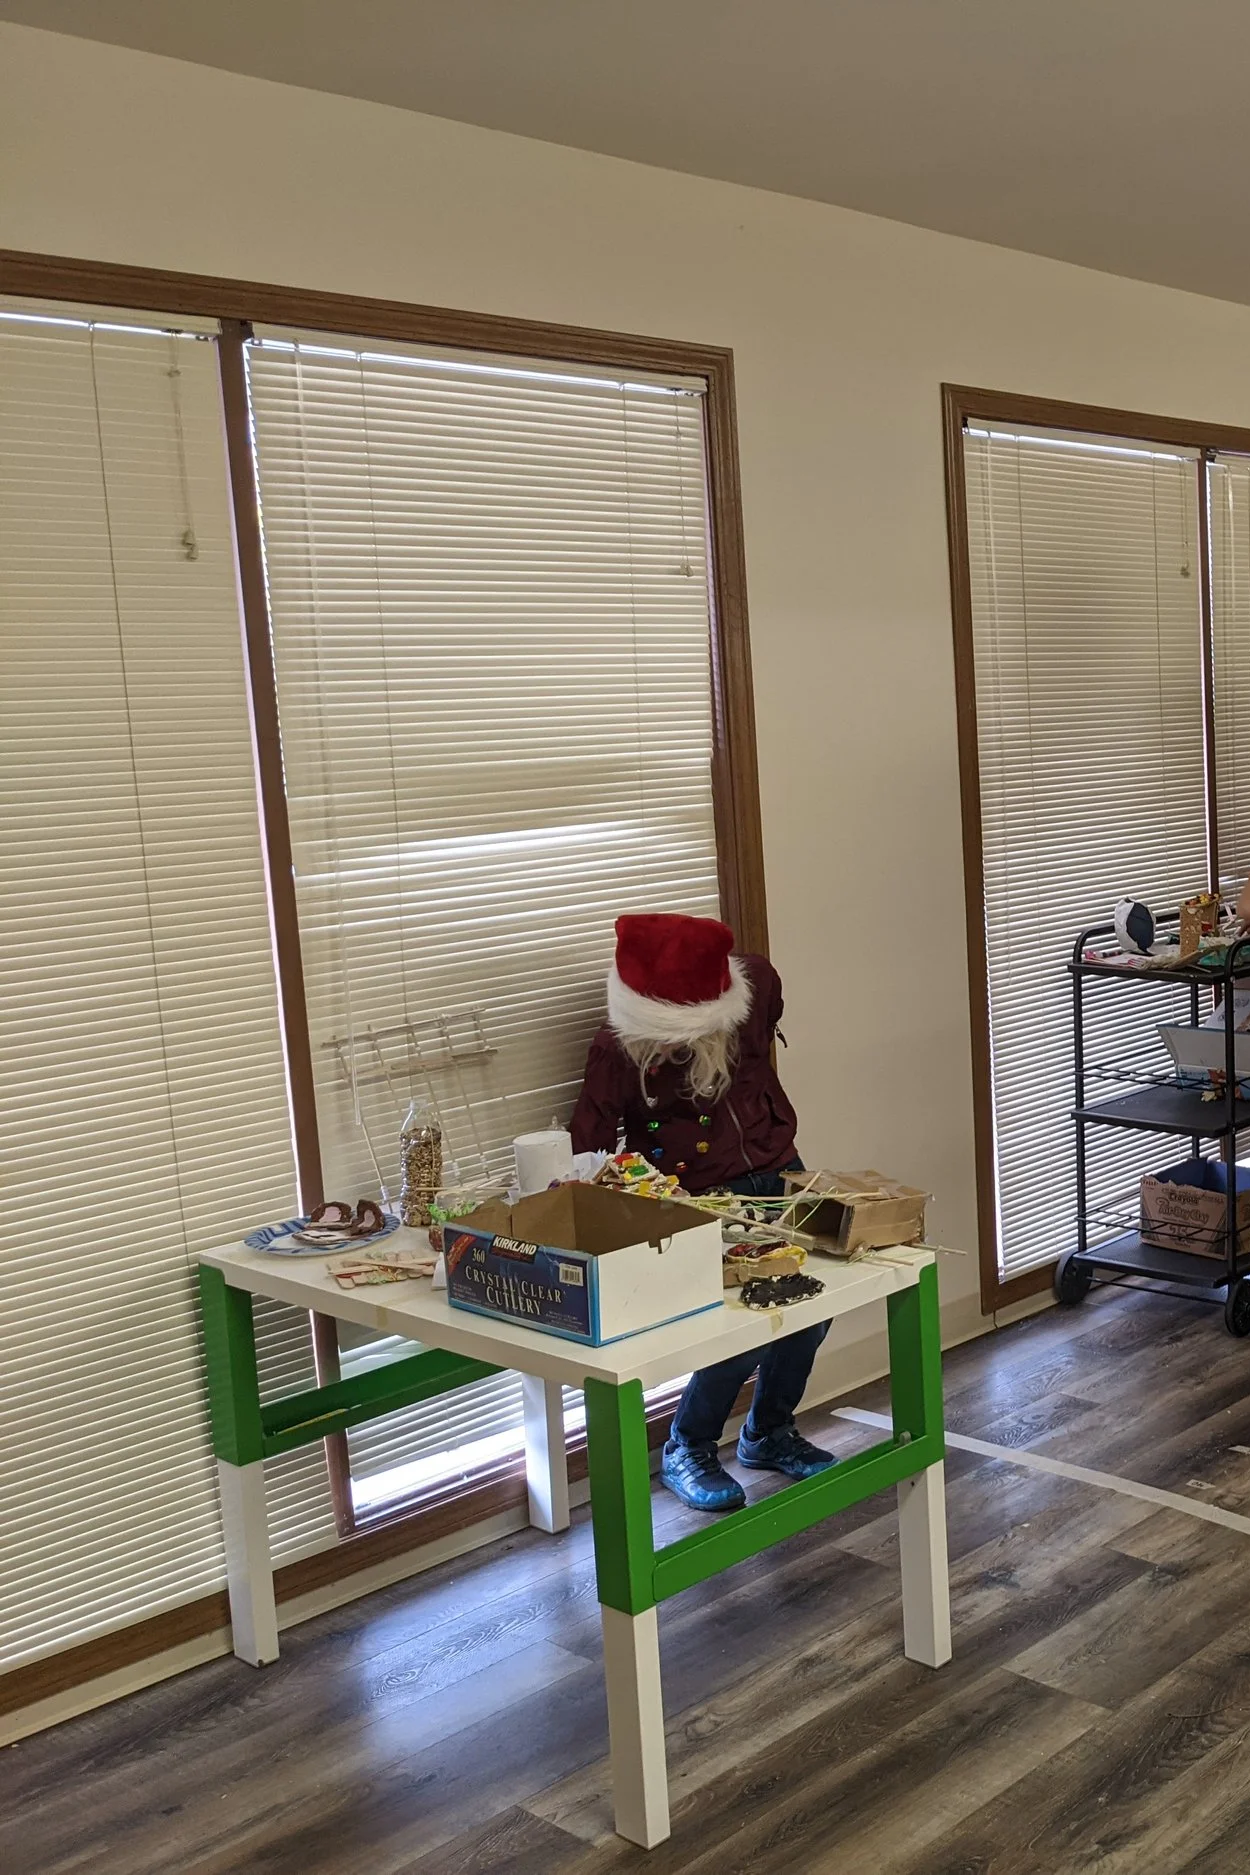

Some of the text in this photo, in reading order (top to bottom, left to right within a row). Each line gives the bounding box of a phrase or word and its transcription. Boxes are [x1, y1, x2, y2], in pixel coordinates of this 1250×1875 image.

[472, 1247, 486, 1264] 360
[493, 1236, 537, 1255] KIRKLAND
[465, 1265, 516, 1292] CRYSTAL
[521, 1280, 562, 1303] CLEAR
[486, 1286, 540, 1315] CUTLERY
